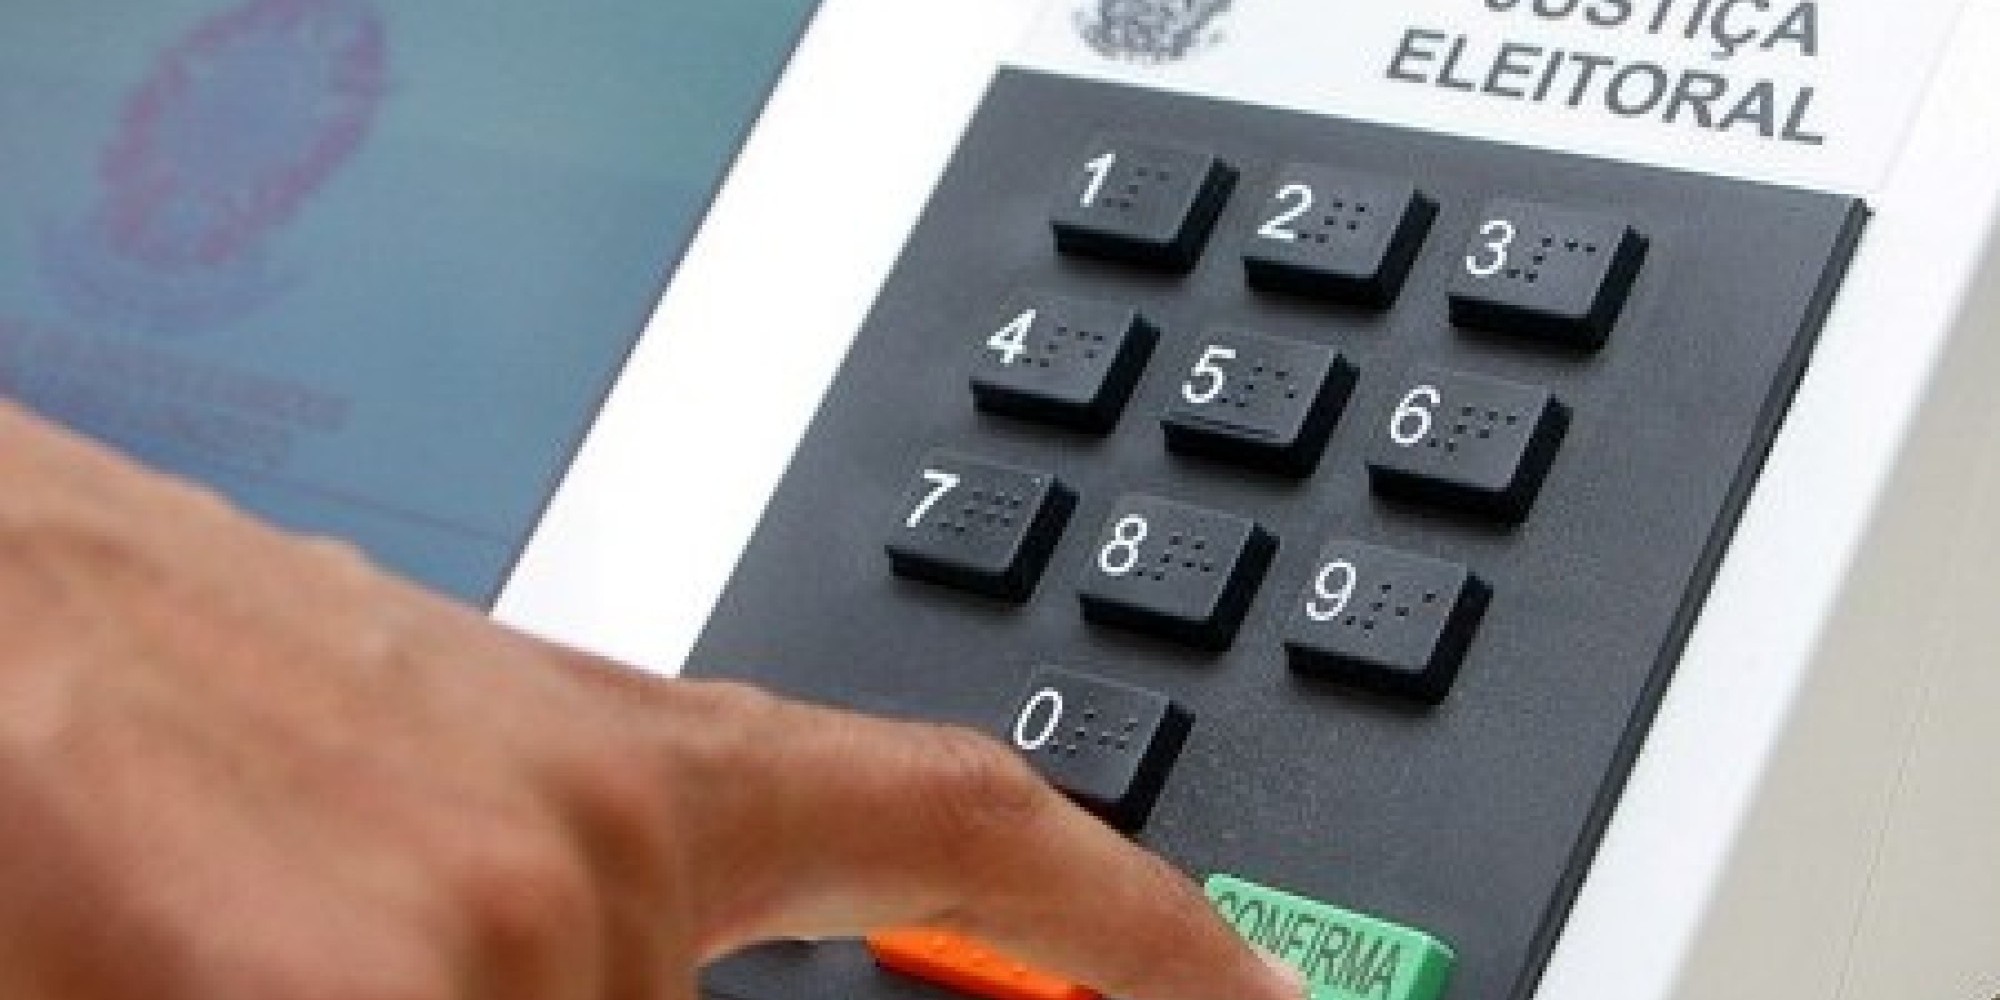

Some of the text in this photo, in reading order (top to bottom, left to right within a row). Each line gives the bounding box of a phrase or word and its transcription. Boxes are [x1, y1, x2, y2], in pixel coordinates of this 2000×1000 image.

[1485, 0, 1820, 60] TIÇA
[1385, 28, 1824, 146] ELEITORAL
[1079, 152, 1117, 209] 1
[1256, 183, 1313, 241] 2
[1465, 218, 1517, 276] 3
[985, 308, 1038, 365] 4
[1180, 343, 1237, 405] 5
[1389, 383, 1442, 445] 6
[905, 468, 962, 529] 7
[1096, 512, 1149, 574] 8
[1305, 557, 1358, 622] 9
[1012, 686, 1064, 751] 0
